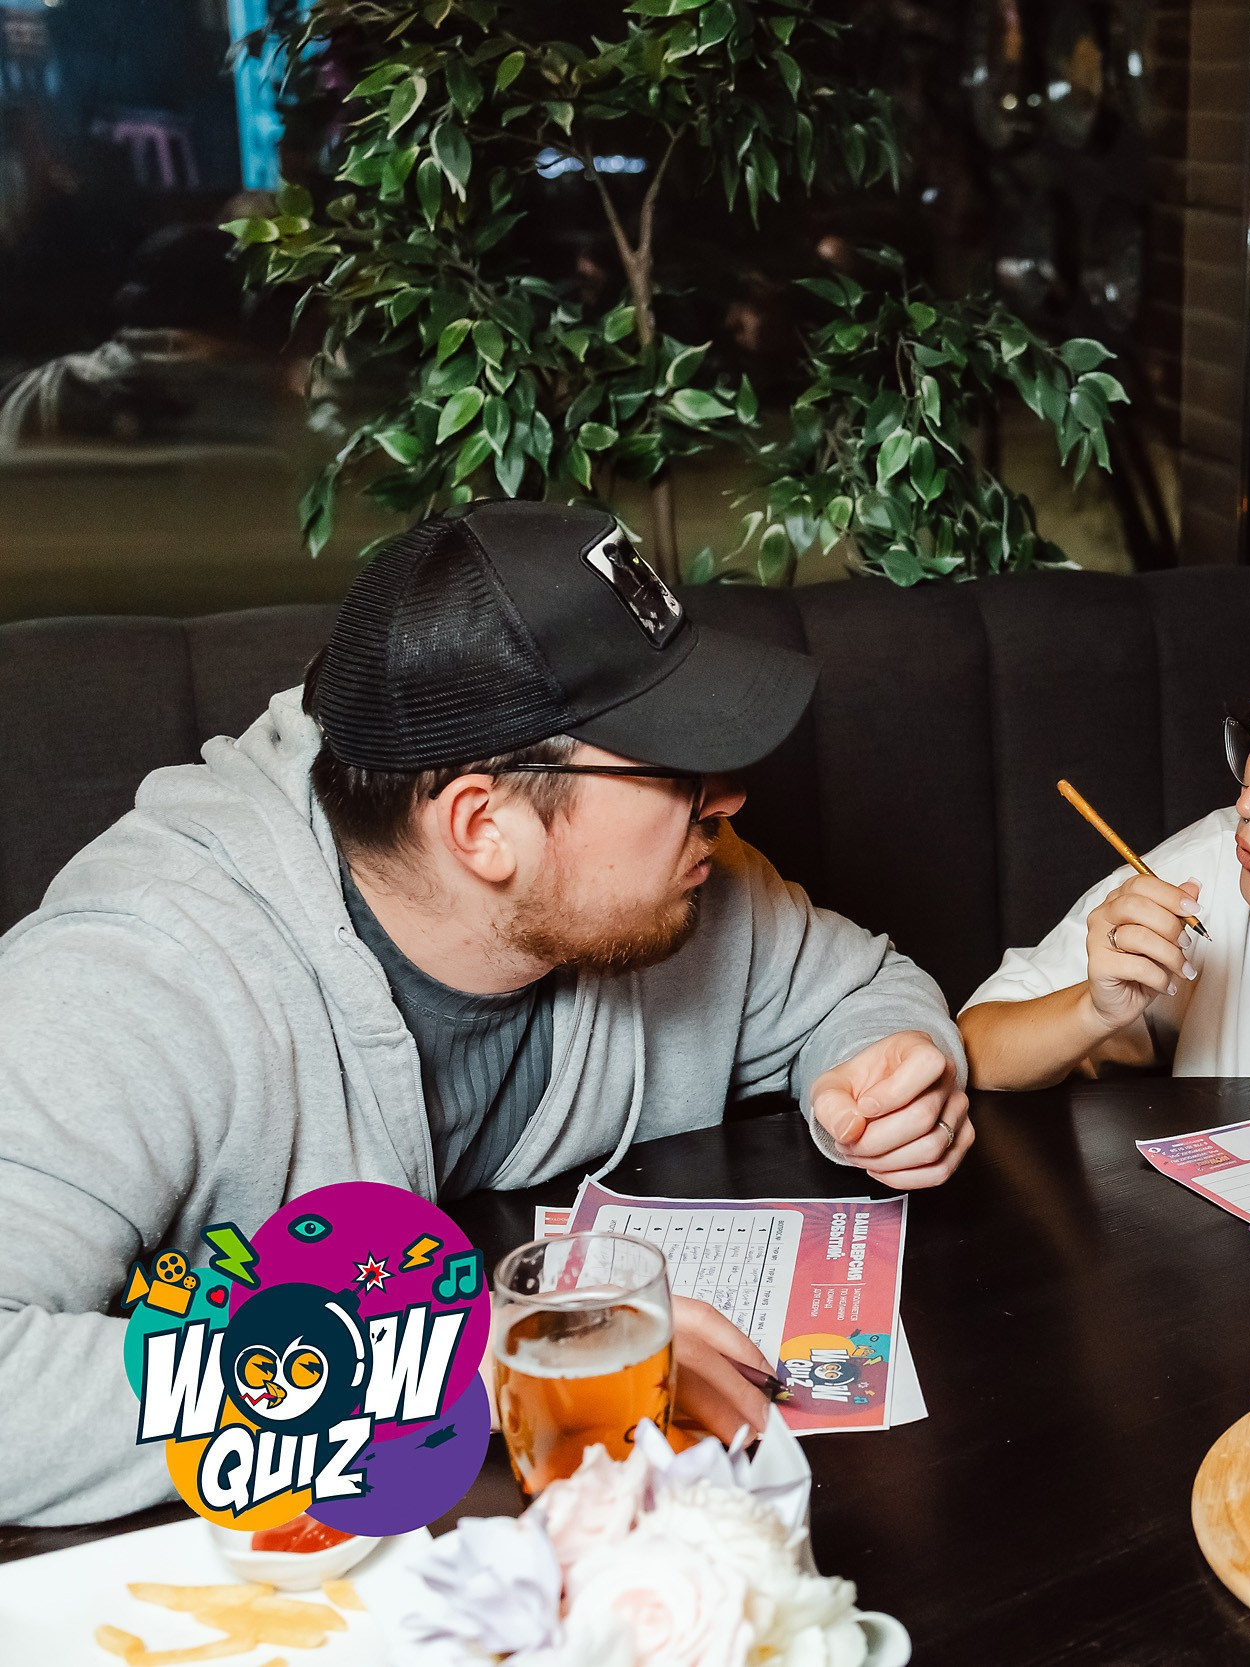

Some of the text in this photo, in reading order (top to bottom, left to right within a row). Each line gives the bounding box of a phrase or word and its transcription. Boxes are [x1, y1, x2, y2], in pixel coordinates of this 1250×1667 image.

[826, 1212, 847, 1260] СОБЫТИЙ:
[846, 1212, 870, 1281] ВАША ВЕРСИЯ
[813, 1288, 821, 1299] ДЛЯ
[824, 1288, 835, 1309] КОМАНД
[837, 1288, 848, 1321] ПО ЖЕЛАНИЮ
[850, 1287, 862, 1321] ЗАПОЛНЯЕТСЯ
[759, 1312, 767, 1322] ТУР
[784, 1359, 814, 1388] QUIZ
[810, 1348, 852, 1403] WOW
